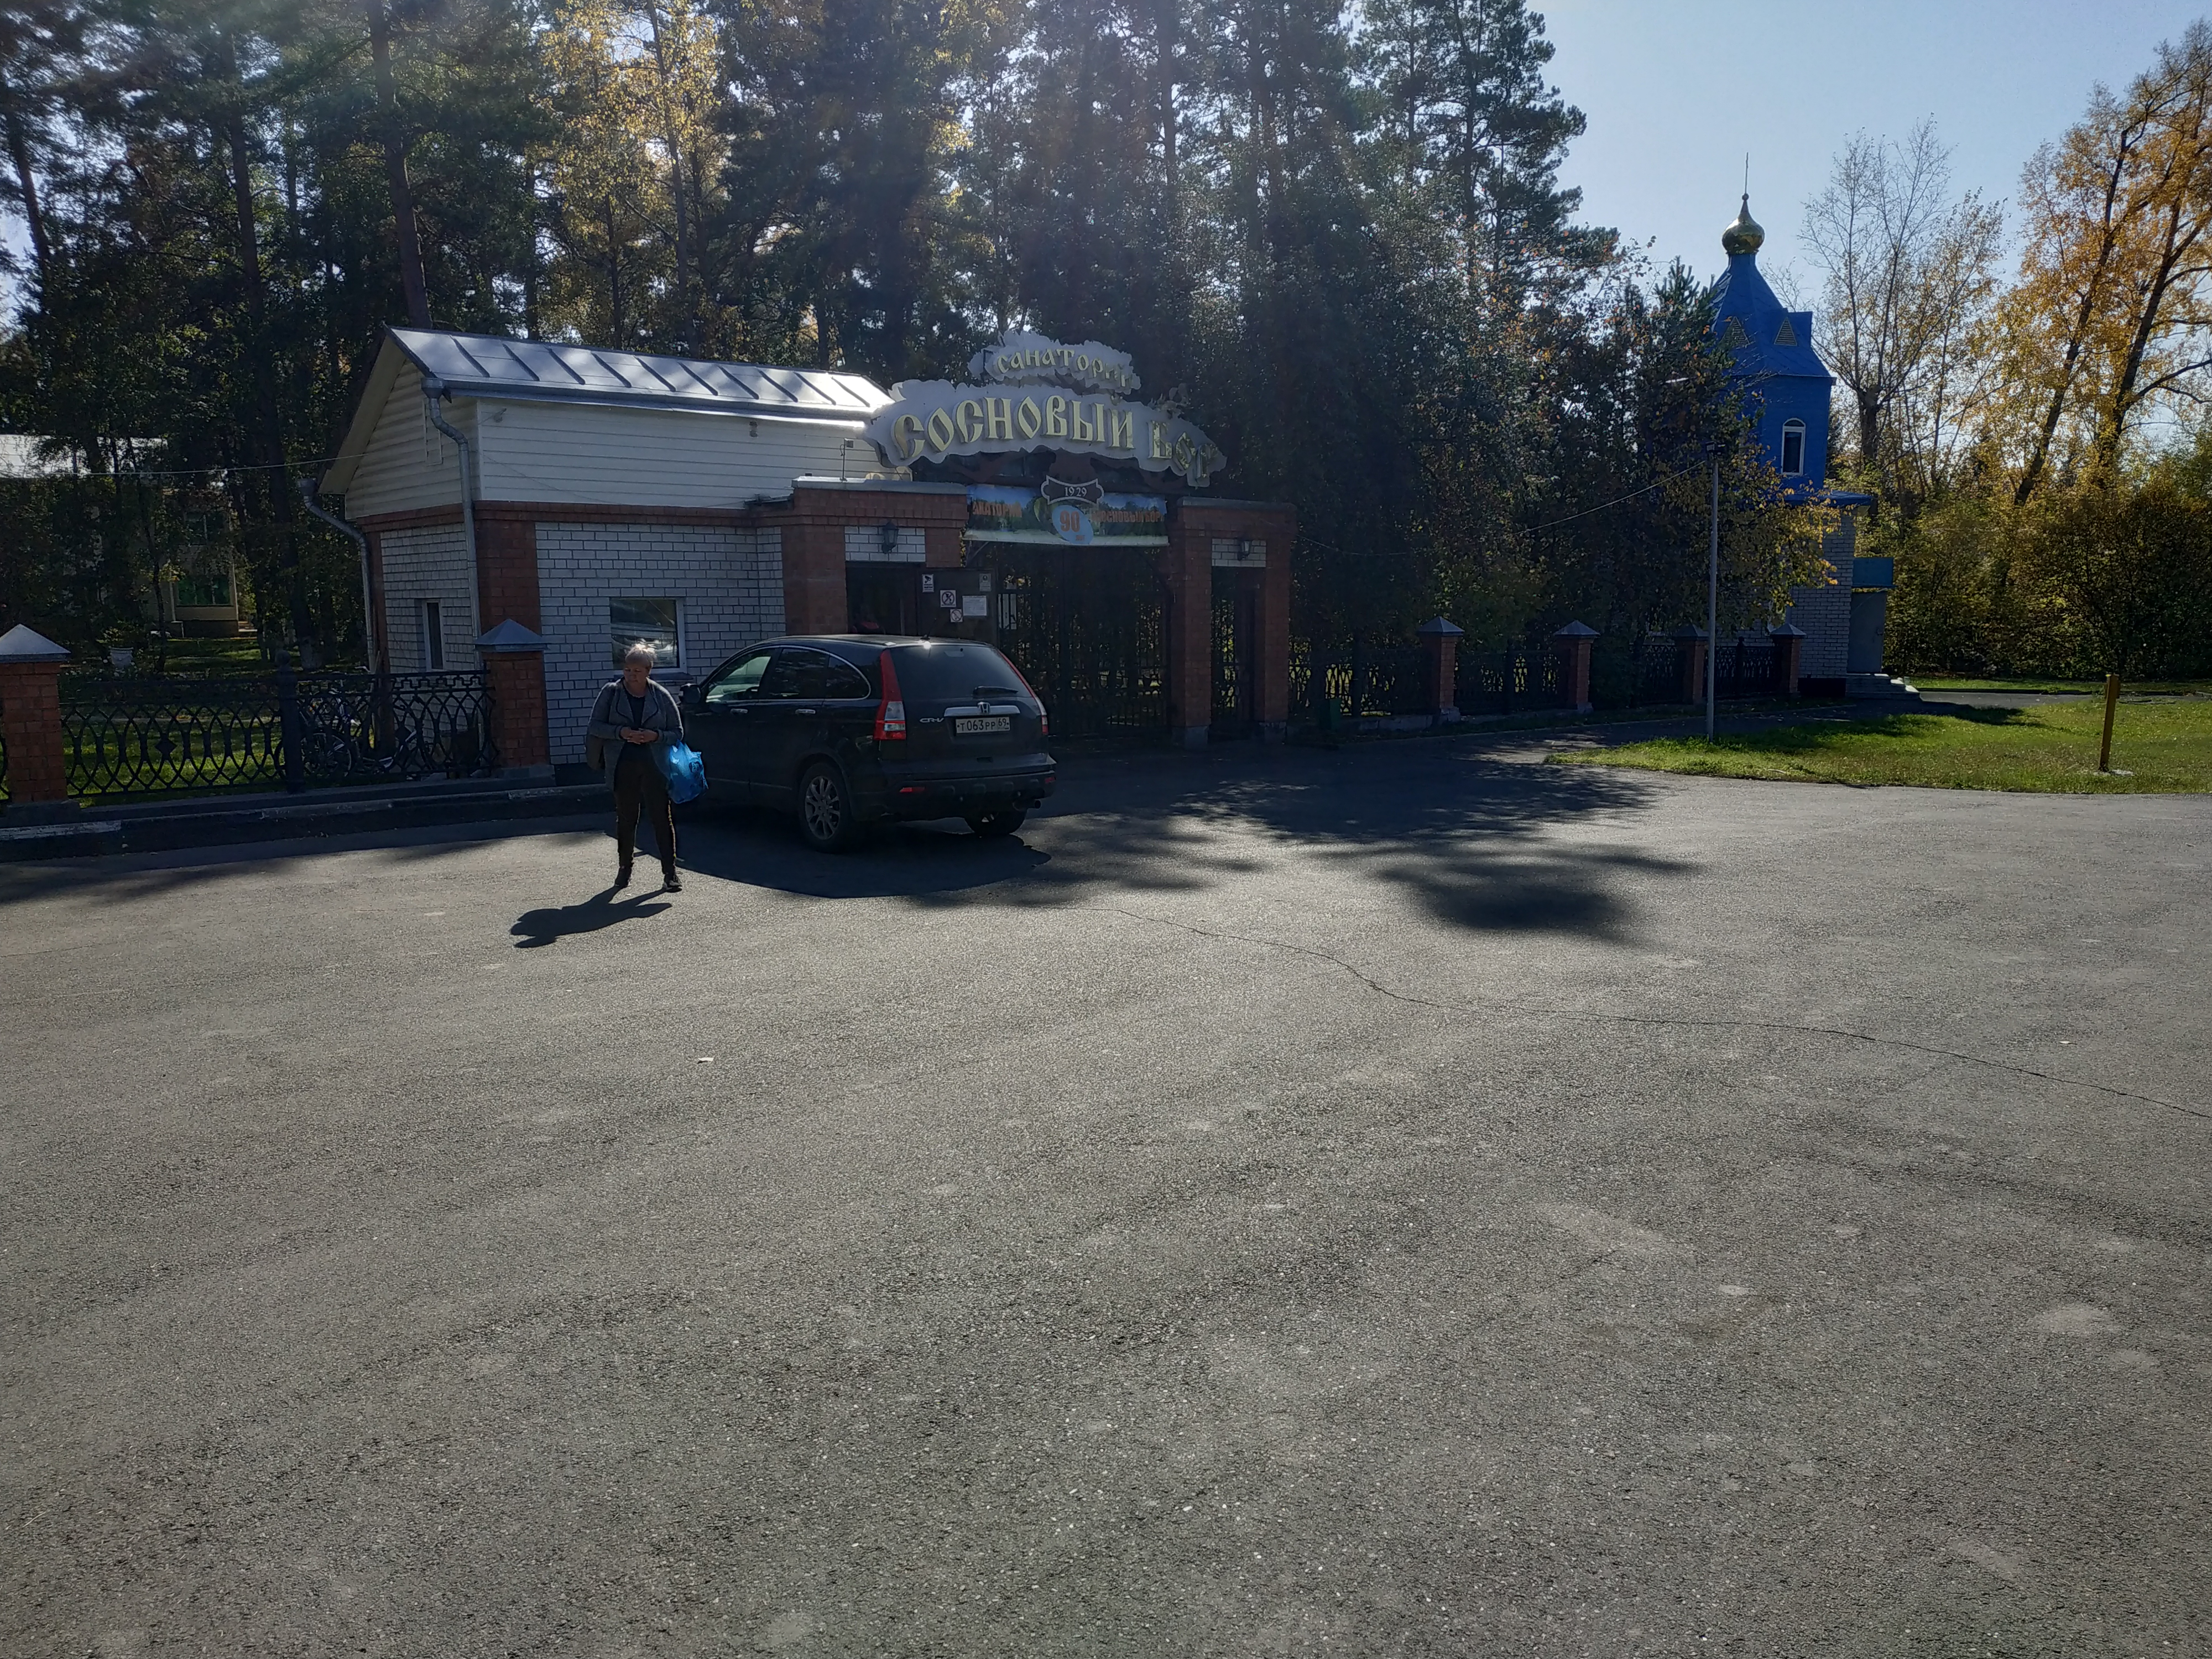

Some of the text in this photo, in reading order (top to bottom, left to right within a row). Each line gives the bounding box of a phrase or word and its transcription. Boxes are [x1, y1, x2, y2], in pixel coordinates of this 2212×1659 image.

[891, 389, 1218, 478] СОСНОВЫЙ БОР
[1064, 486, 1087, 497] 1929
[1060, 510, 1080, 533] 90
